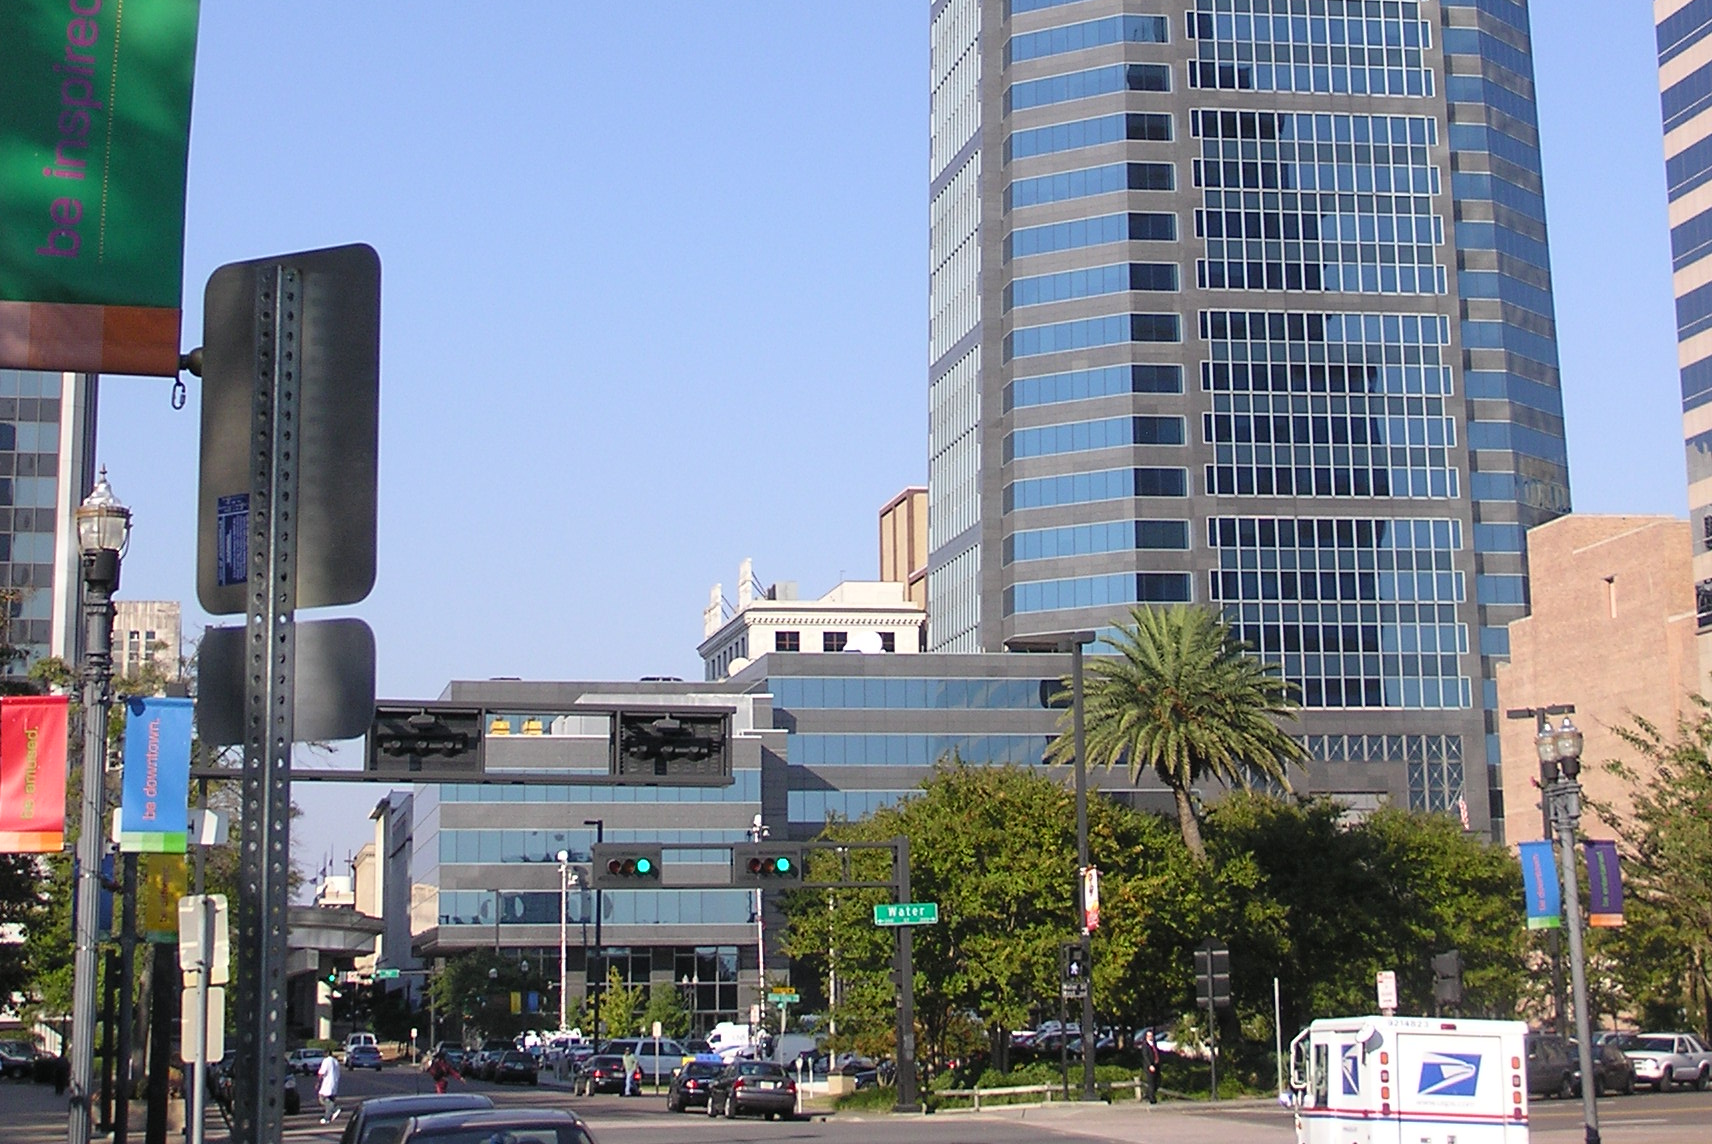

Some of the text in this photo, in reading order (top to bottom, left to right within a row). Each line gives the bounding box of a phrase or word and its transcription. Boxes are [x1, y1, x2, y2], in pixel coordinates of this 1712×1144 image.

[36, 197, 83, 257] be
[21, 798, 35, 820] be
[142, 802, 157, 821] be
[888, 906, 925, 917] Water
